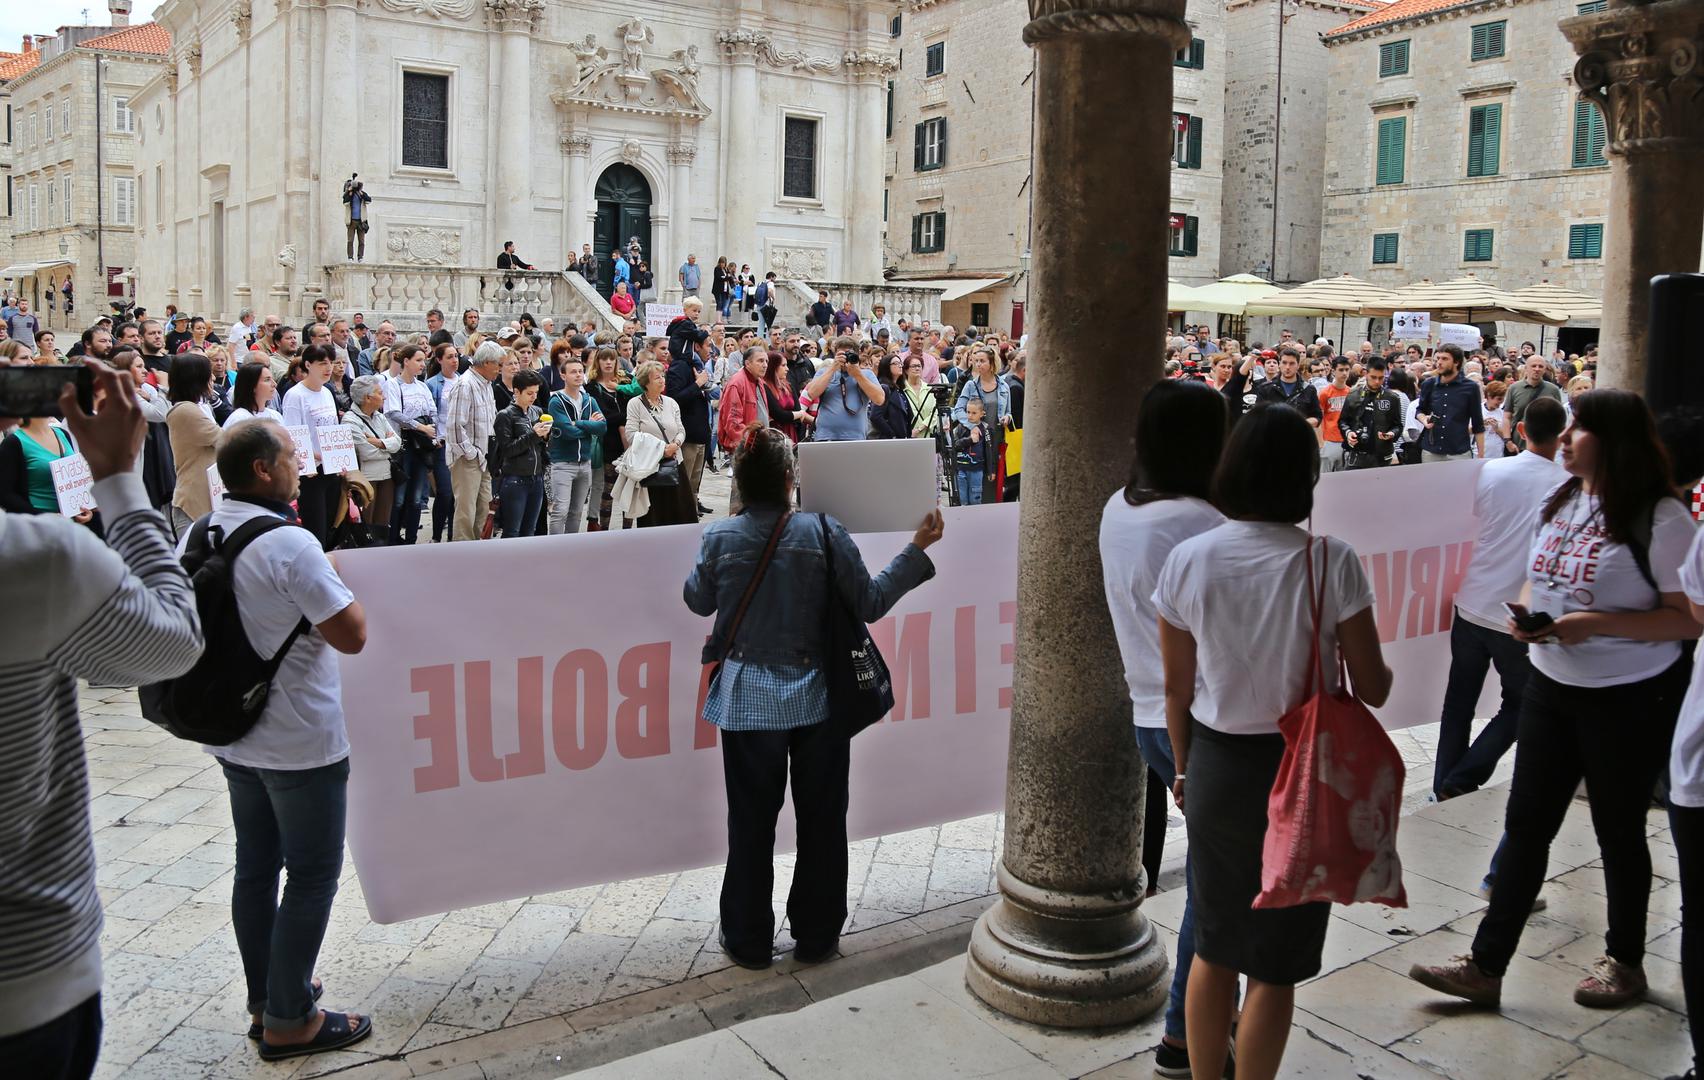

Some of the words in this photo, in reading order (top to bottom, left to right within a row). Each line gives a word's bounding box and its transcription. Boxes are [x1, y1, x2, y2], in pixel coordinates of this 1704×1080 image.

[319, 428, 352, 443] Hrvatska
[1543, 535, 1602, 560] MOŽE
[1532, 554, 1598, 584] BOLJE
